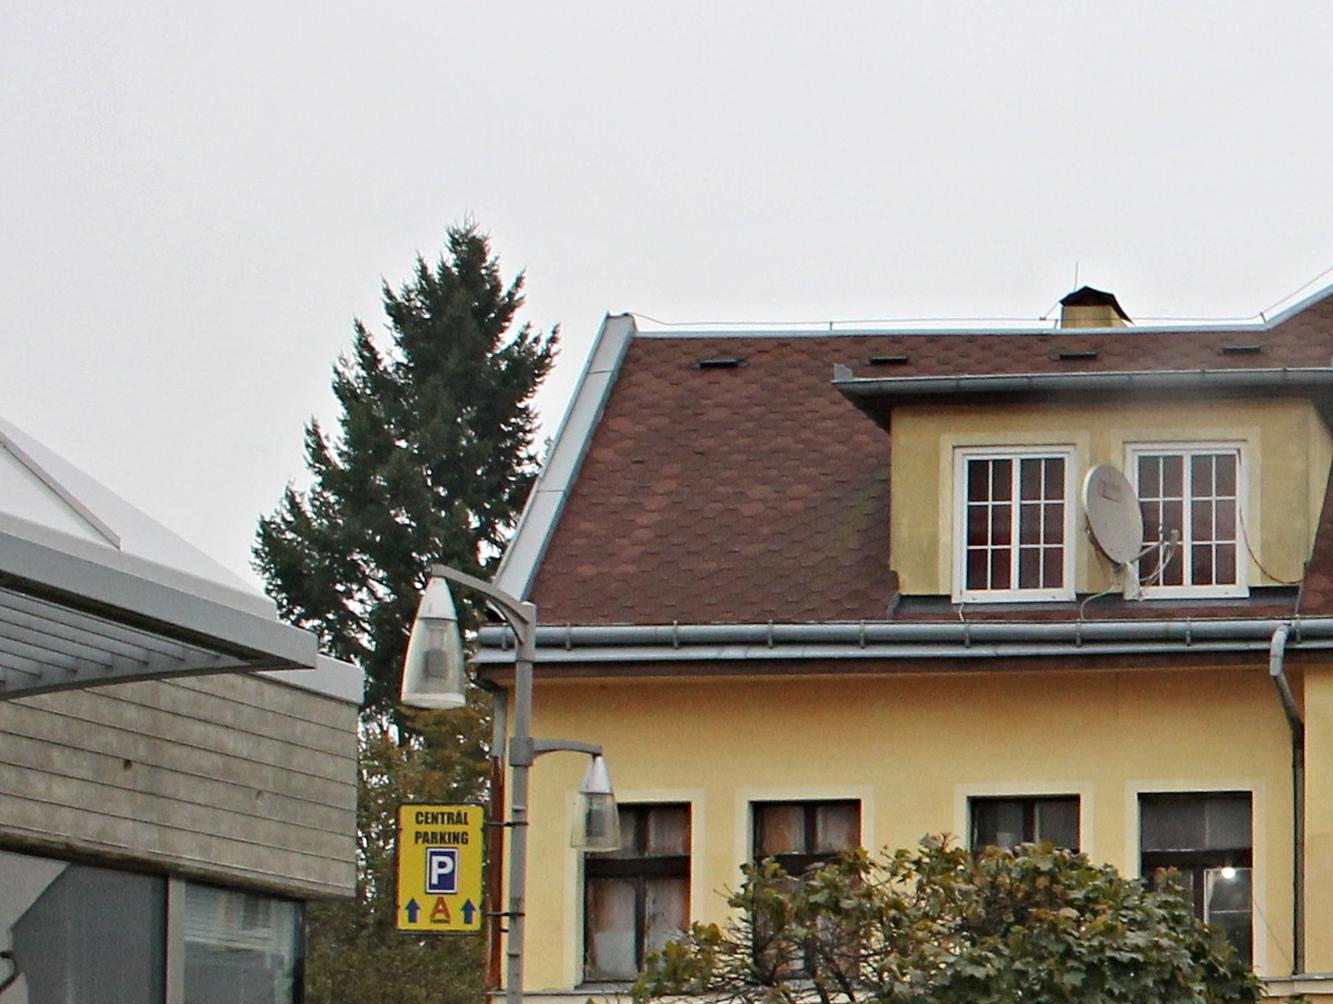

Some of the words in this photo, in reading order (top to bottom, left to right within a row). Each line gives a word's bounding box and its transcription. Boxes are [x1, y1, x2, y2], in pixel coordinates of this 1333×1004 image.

[415, 809, 469, 825] CENTRÁL
[414, 831, 469, 845] PARKING
[431, 855, 454, 885] P
